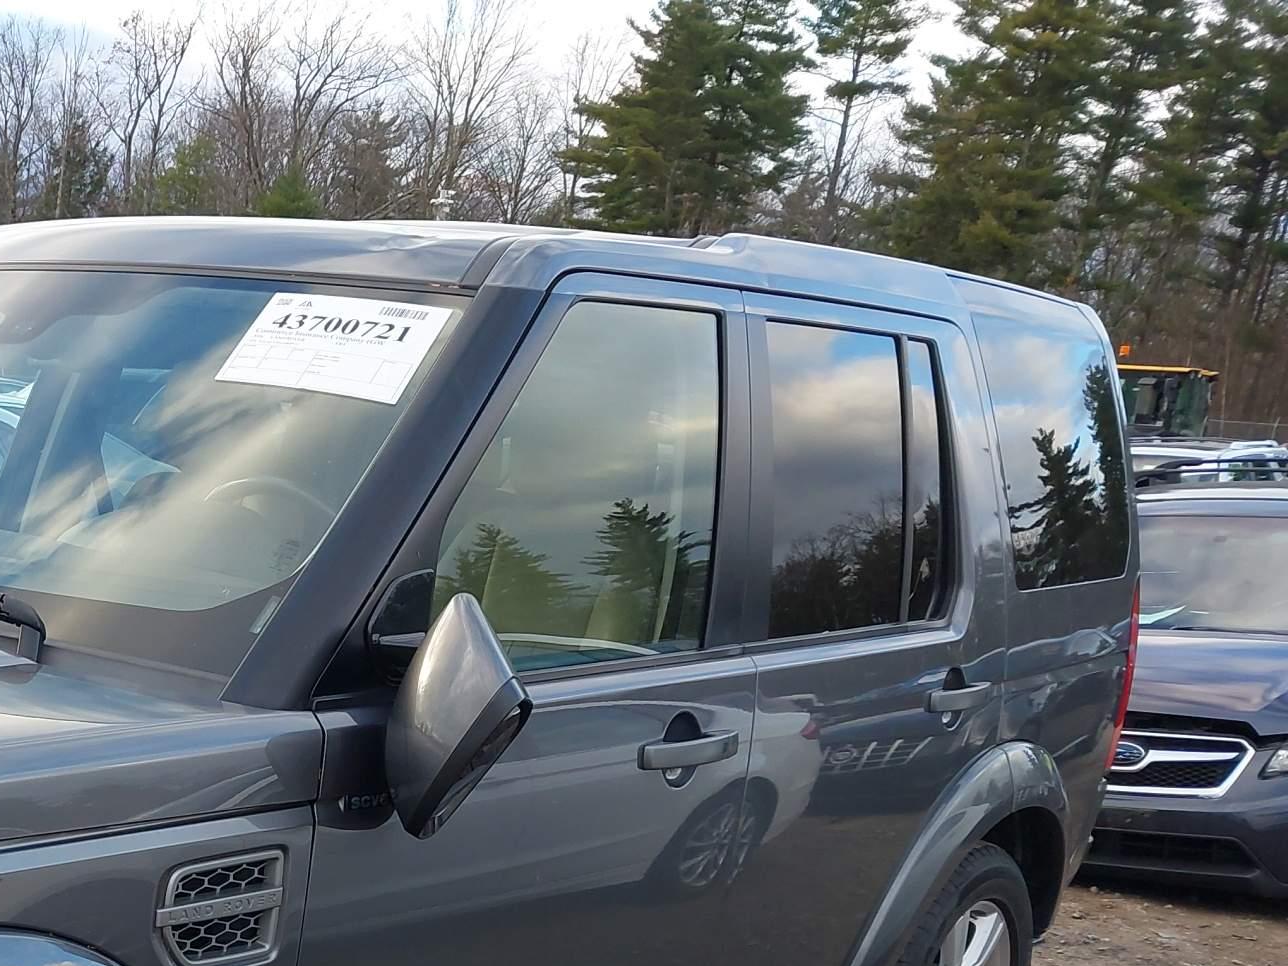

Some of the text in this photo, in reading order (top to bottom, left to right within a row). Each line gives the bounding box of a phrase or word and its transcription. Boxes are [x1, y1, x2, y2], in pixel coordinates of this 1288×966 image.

[272, 312, 412, 343] 43700721
[168, 893, 278, 924] LAND ROVER
